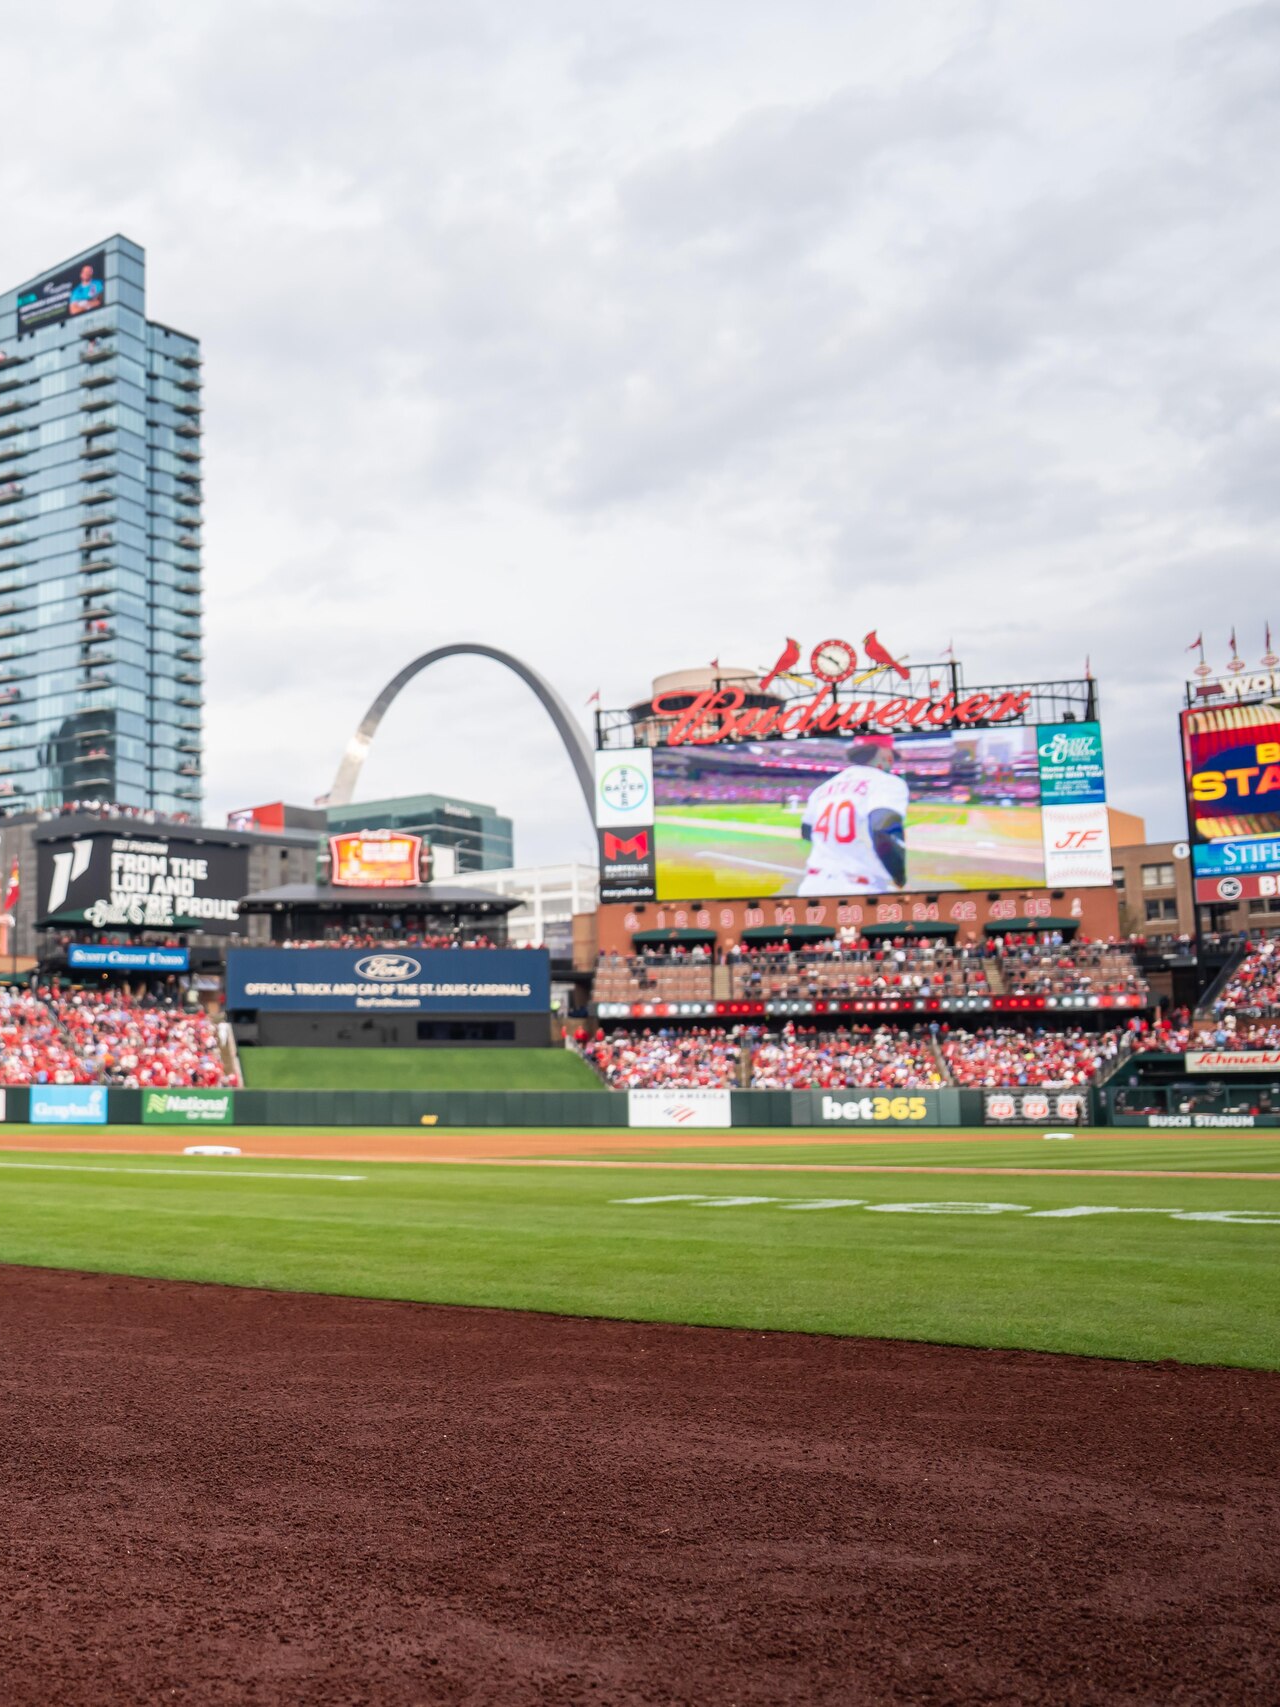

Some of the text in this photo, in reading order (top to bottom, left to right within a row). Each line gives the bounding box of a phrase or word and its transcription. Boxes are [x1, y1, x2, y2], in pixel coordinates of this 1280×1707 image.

[652, 682, 1031, 746] Budweiser
[605, 784, 645, 792] BAYER
[814, 800, 856, 843] 40
[111, 852, 208, 880] FROM THE
[111, 873, 194, 897] LOU AND
[111, 891, 173, 915] WE'RE
[366, 957, 410, 977] Ford
[245, 983, 295, 996] OFFICIAL
[295, 983, 332, 996] TRUCK
[332, 983, 357, 996] AND
[357, 983, 380, 996] CAR
[380, 983, 396, 996] OF
[397, 983, 419, 996] THE
[436, 983, 468, 996] LOUIS
[469, 983, 531, 996] CARDINALS
[166, 1095, 230, 1112] National
[633, 1092, 726, 1100] BANK OF AMERICA
[822, 1096, 926, 1121] bet365
[1149, 1115, 1254, 1128] BUSCH STADIUM
